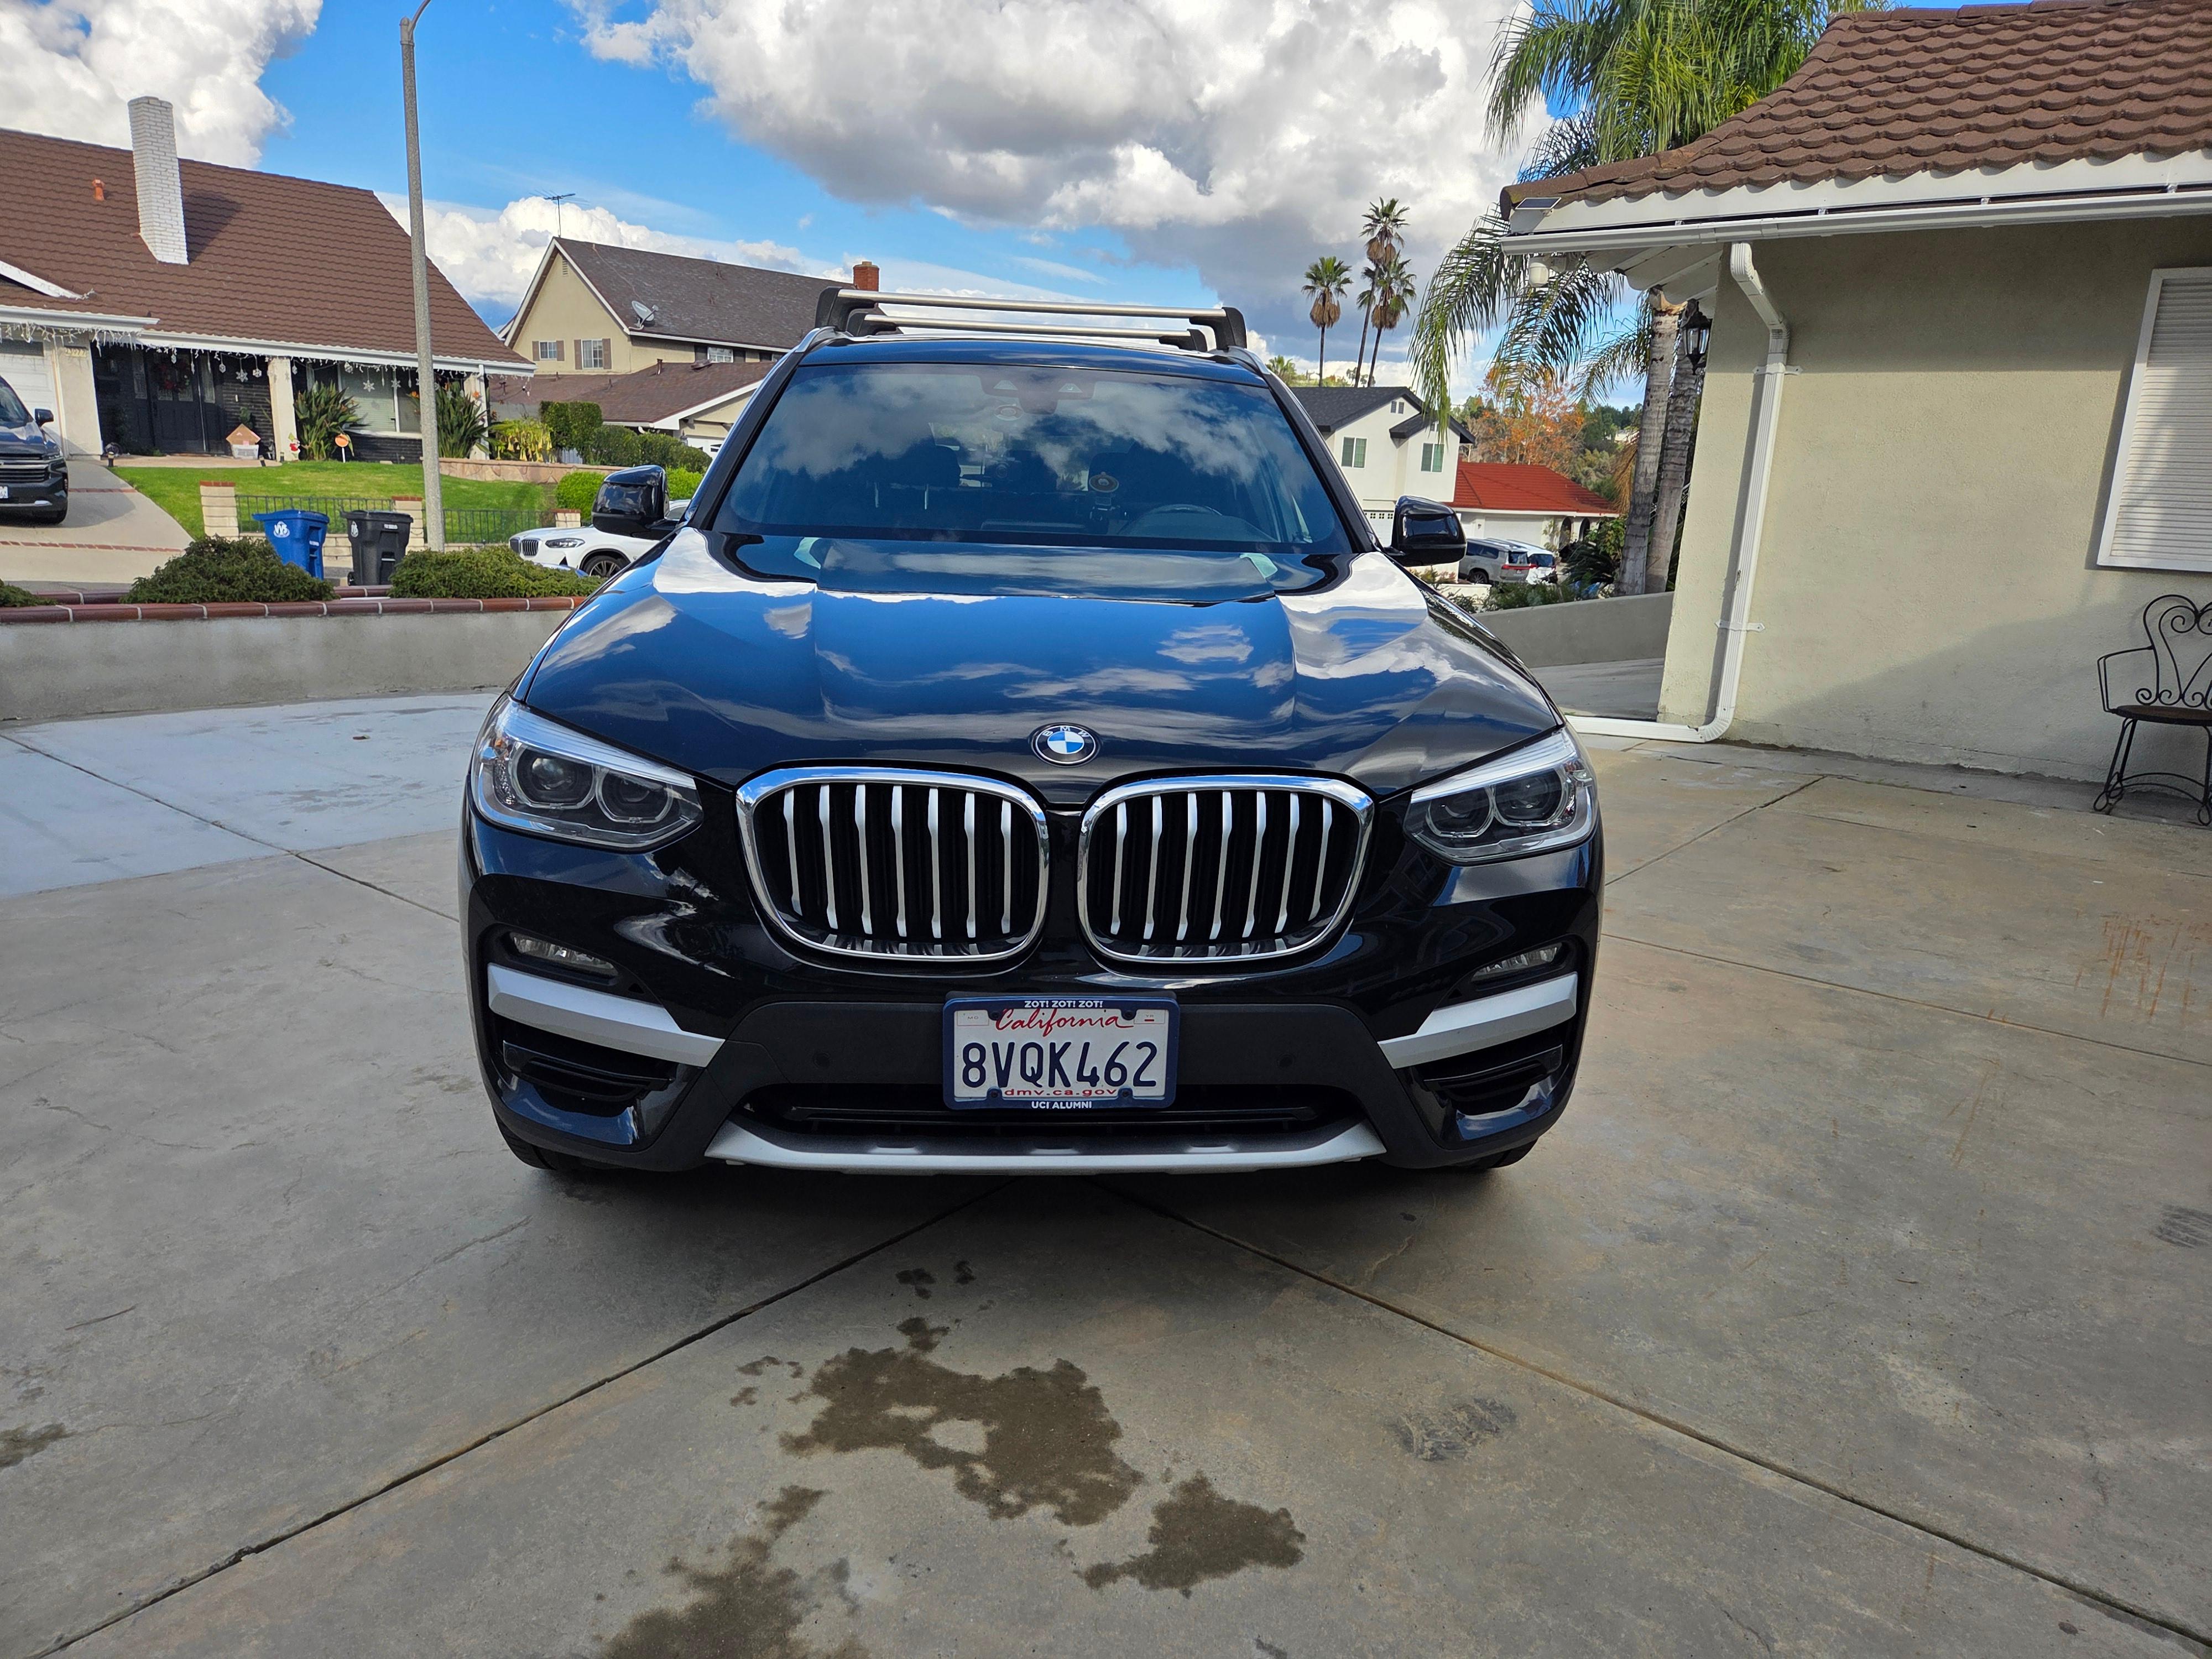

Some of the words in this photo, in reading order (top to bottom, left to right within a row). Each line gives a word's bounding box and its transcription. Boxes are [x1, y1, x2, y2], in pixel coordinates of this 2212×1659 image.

[1042, 726, 1090, 737] BMW
[995, 1009, 1134, 1037] California
[962, 1041, 1157, 1088] 8VQK462
[1004, 1088, 1117, 1097] dmv.ca.gov
[1031, 1101, 1050, 1109] UCI
[1052, 1101, 1092, 1109] ALUMNI
